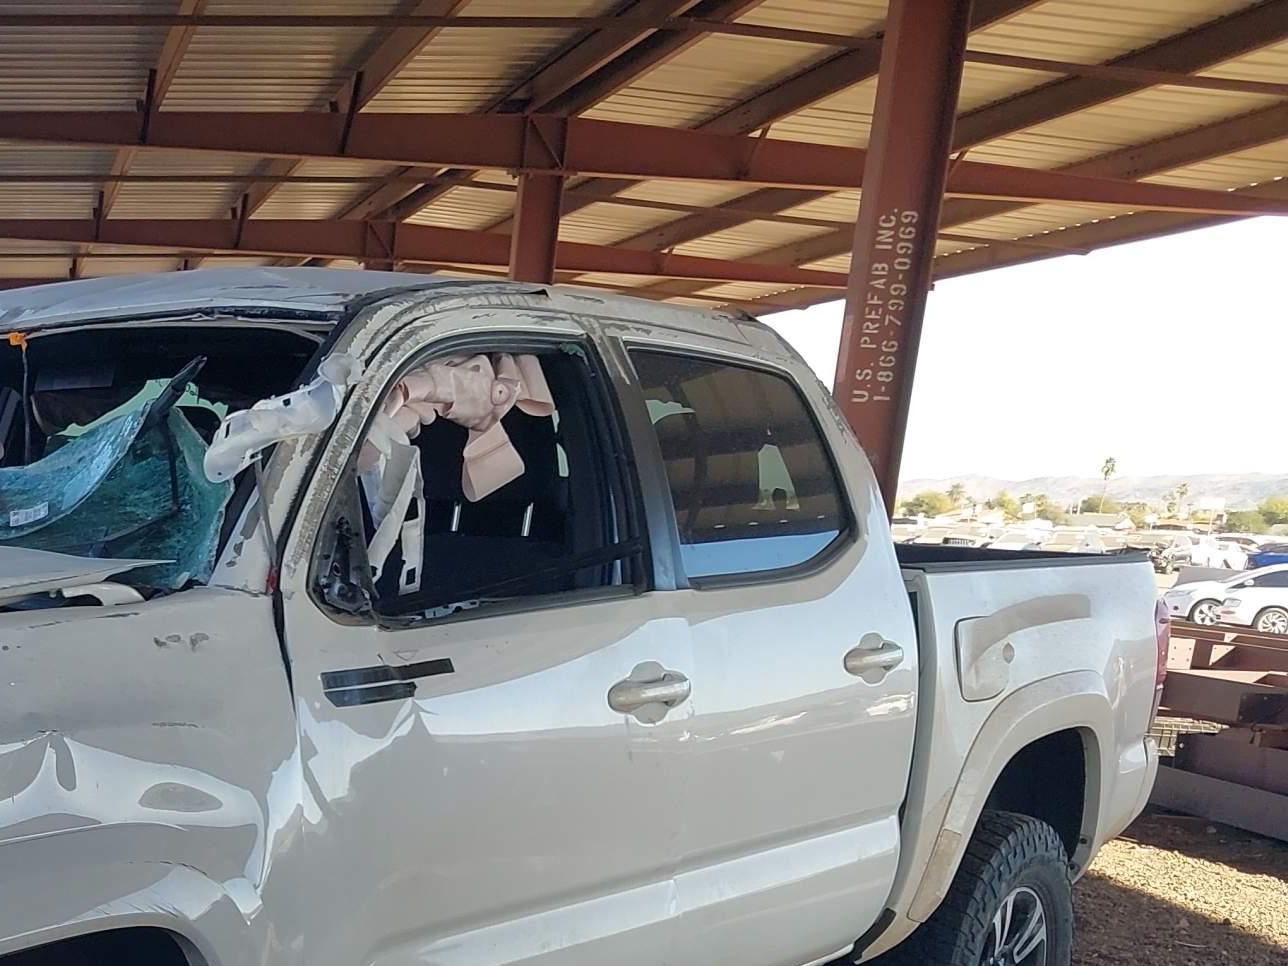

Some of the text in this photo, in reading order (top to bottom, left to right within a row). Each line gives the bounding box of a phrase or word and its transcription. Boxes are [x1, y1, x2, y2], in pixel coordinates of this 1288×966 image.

[851, 208, 899, 402] U.S. PREFAB INC.
[873, 210, 919, 401] 1-866-799-0969
